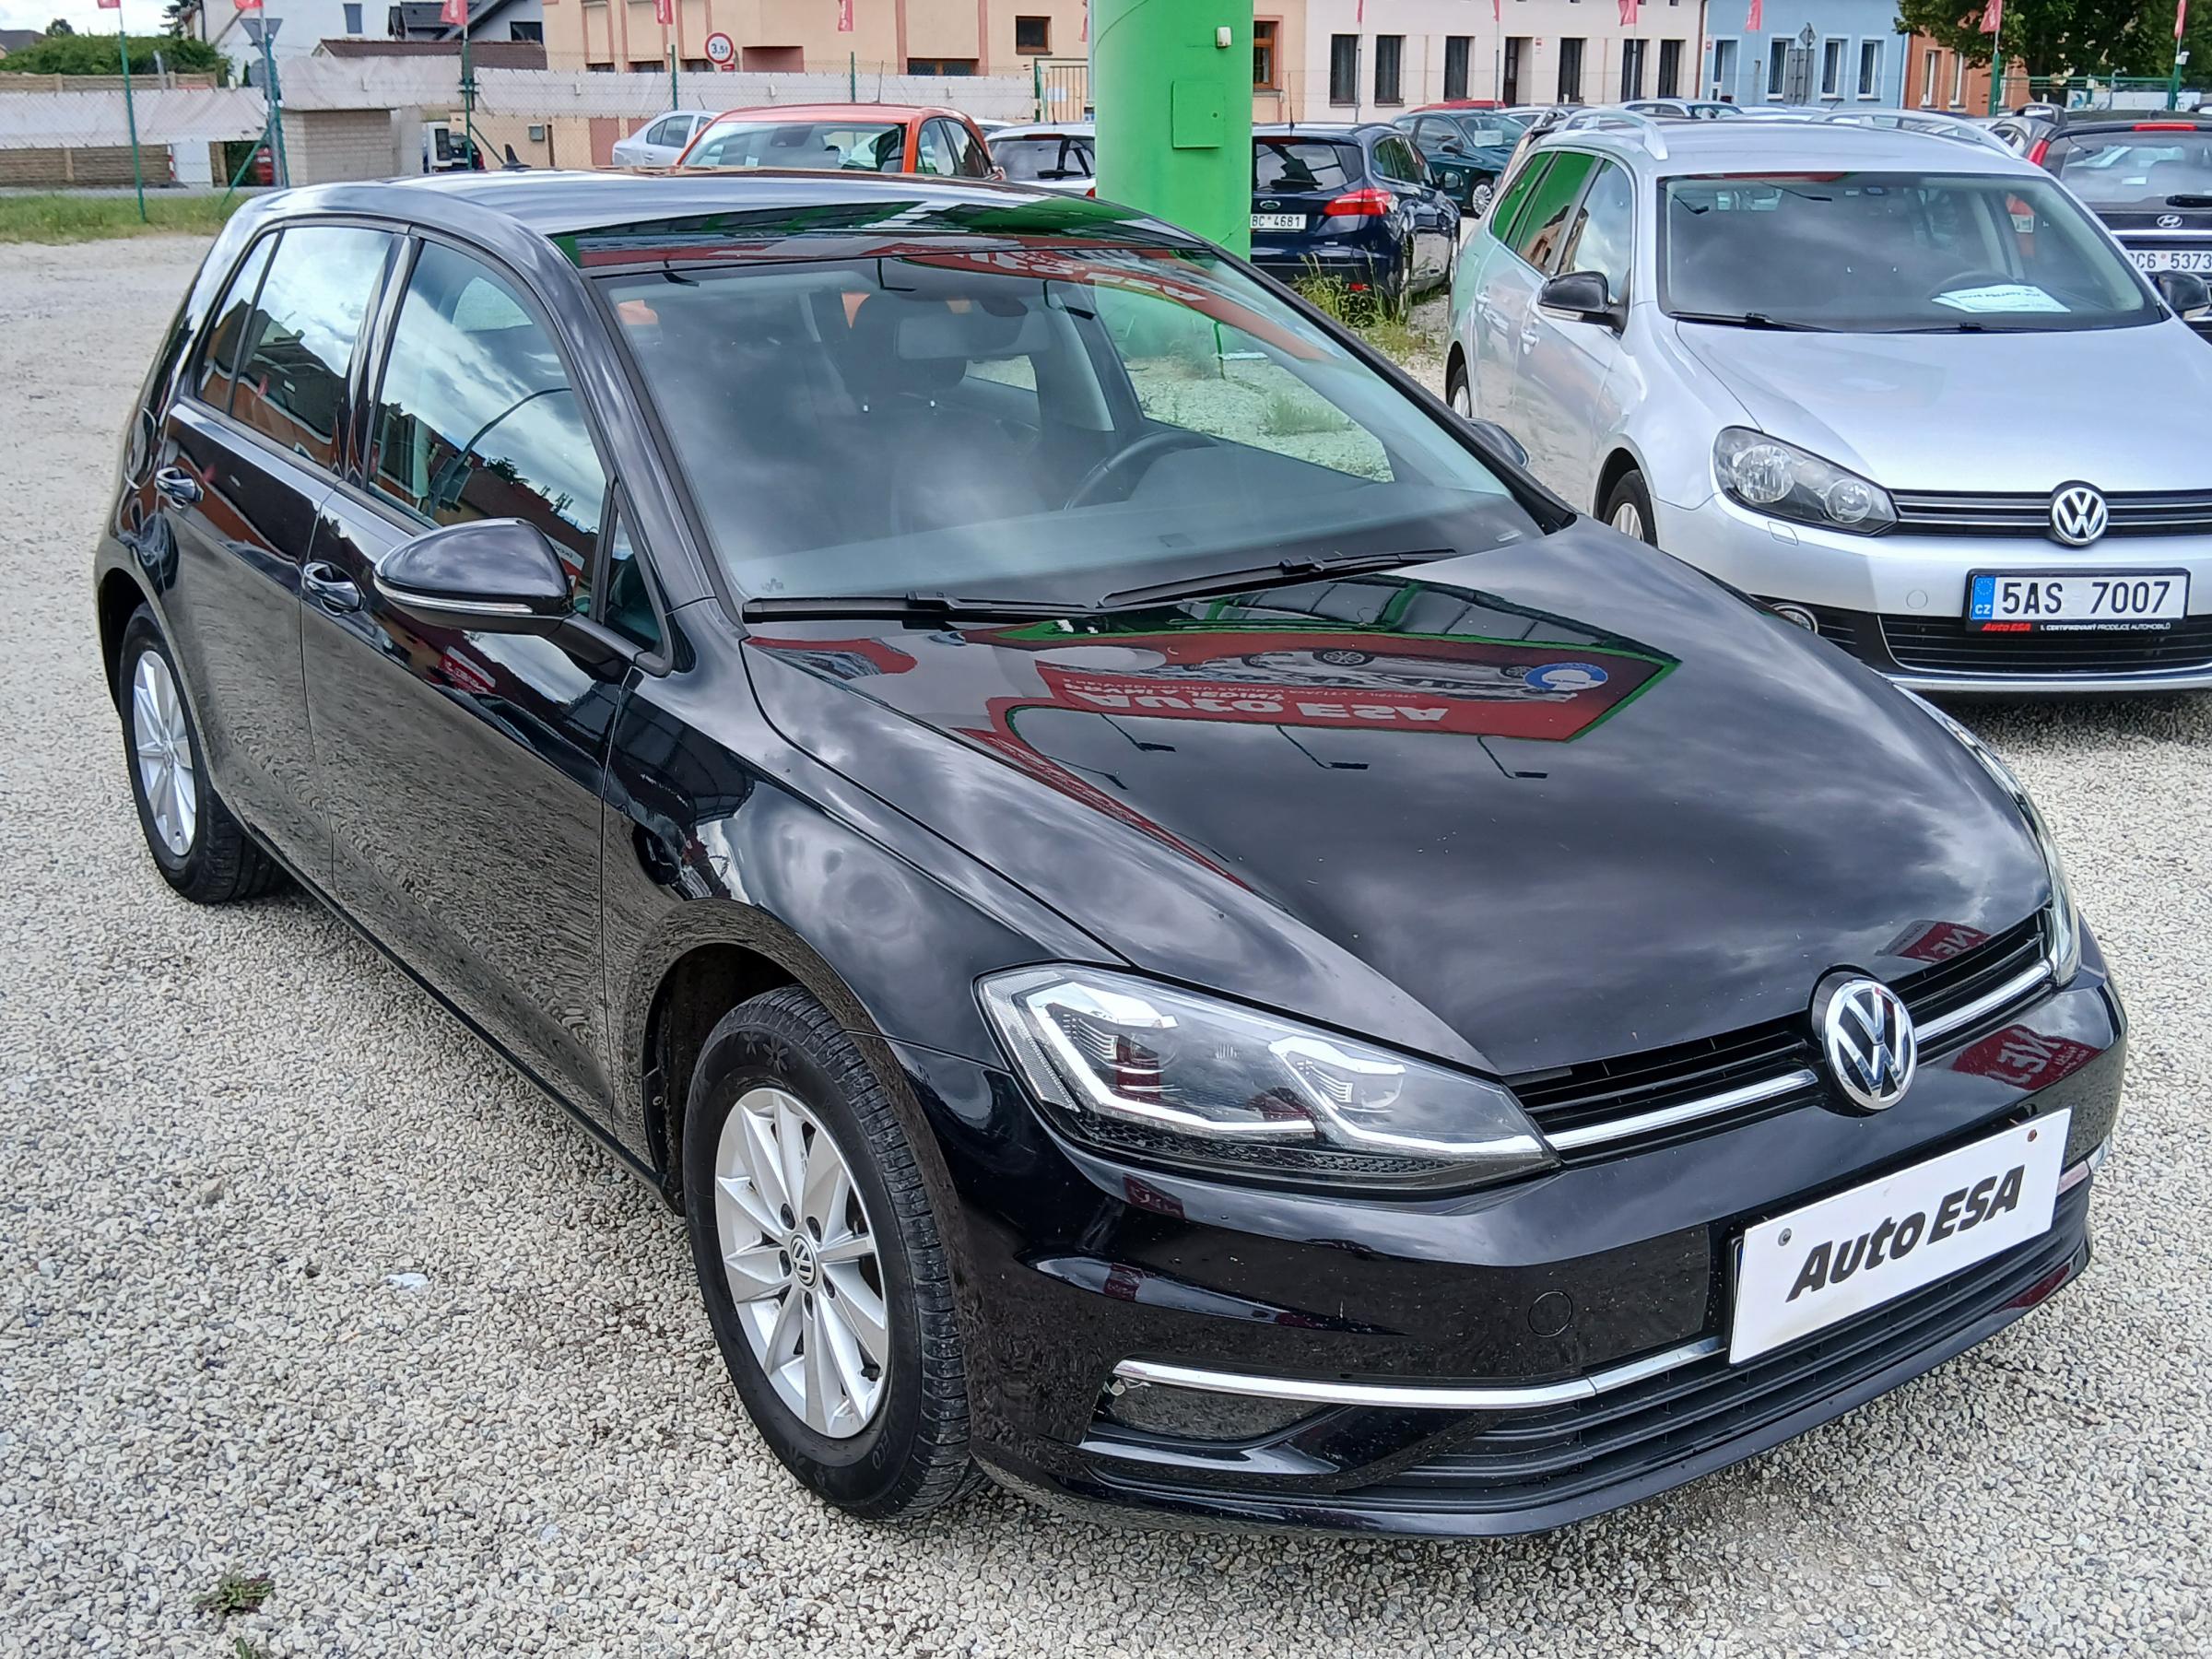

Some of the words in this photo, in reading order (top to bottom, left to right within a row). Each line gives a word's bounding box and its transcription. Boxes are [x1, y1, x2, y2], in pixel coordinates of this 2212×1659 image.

[1274, 216, 1300, 228] 4681
[2170, 253, 2212, 269] 5373
[2001, 582, 2063, 615] 5AS
[2089, 581, 2171, 614] 7007
[1974, 604, 1992, 615] CZ
[1925, 1164, 2026, 1246] ESA
